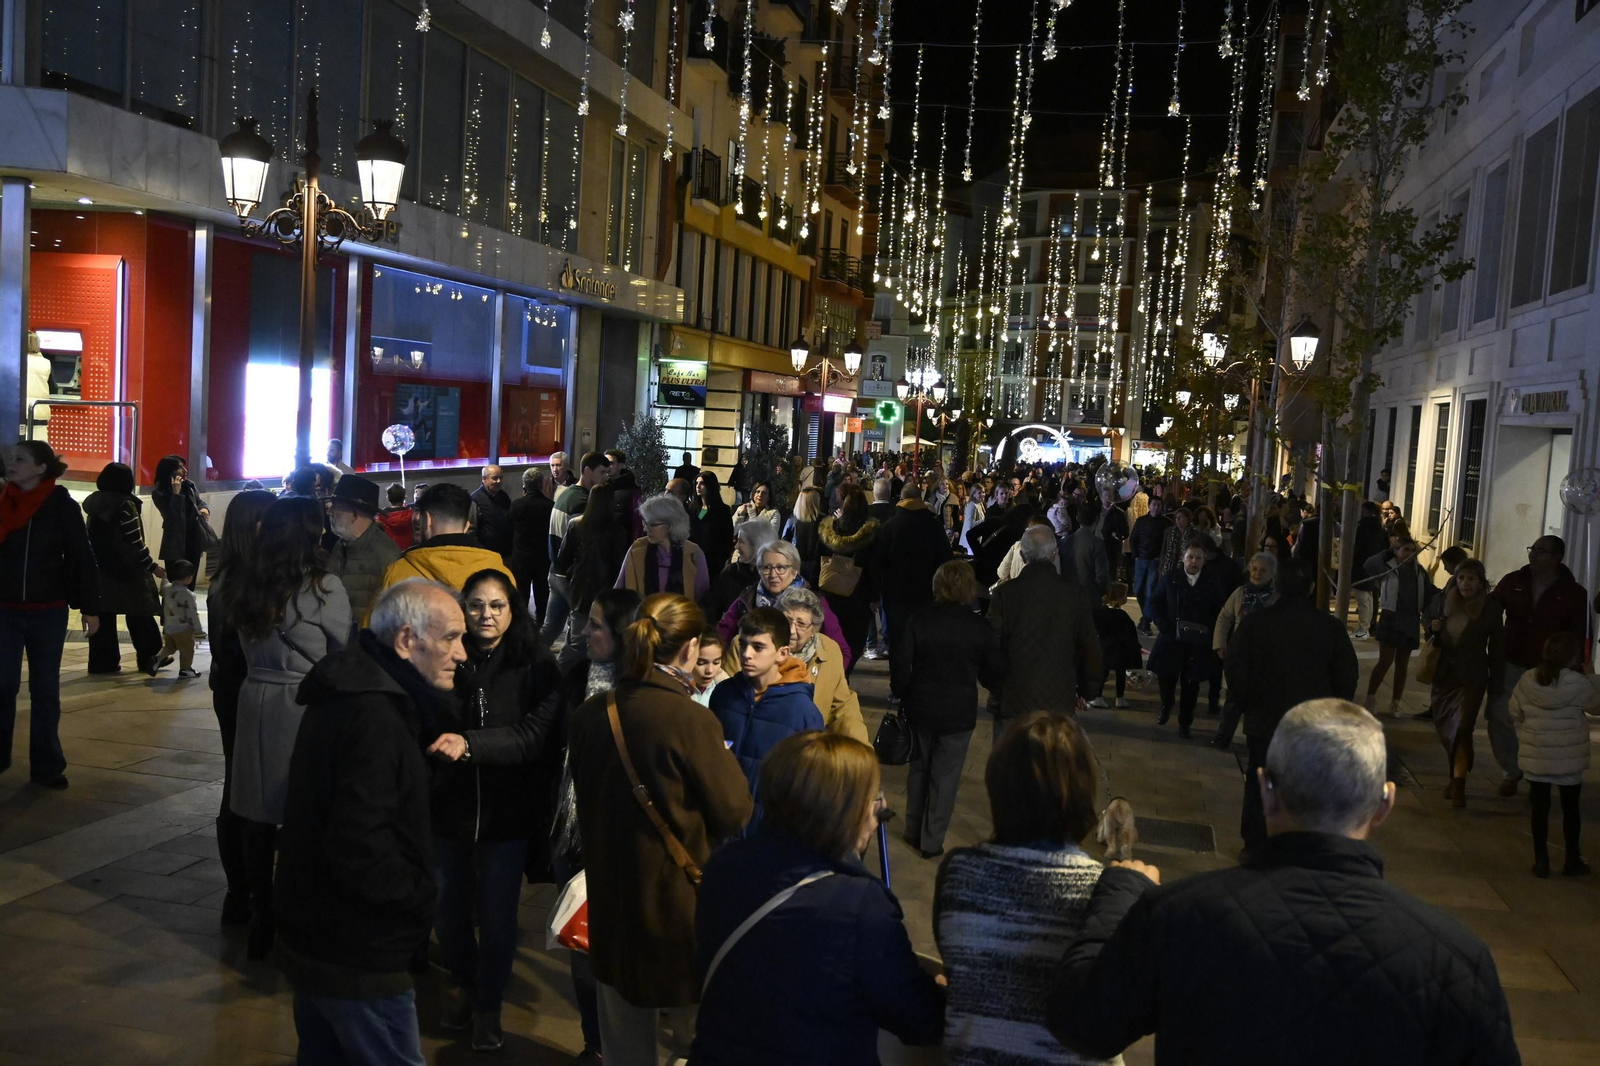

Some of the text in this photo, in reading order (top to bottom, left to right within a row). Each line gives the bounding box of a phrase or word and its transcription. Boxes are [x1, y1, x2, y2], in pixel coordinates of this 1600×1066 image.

[574, 269, 617, 299] Santander
[661, 377, 706, 386] PLUS ULTRA
